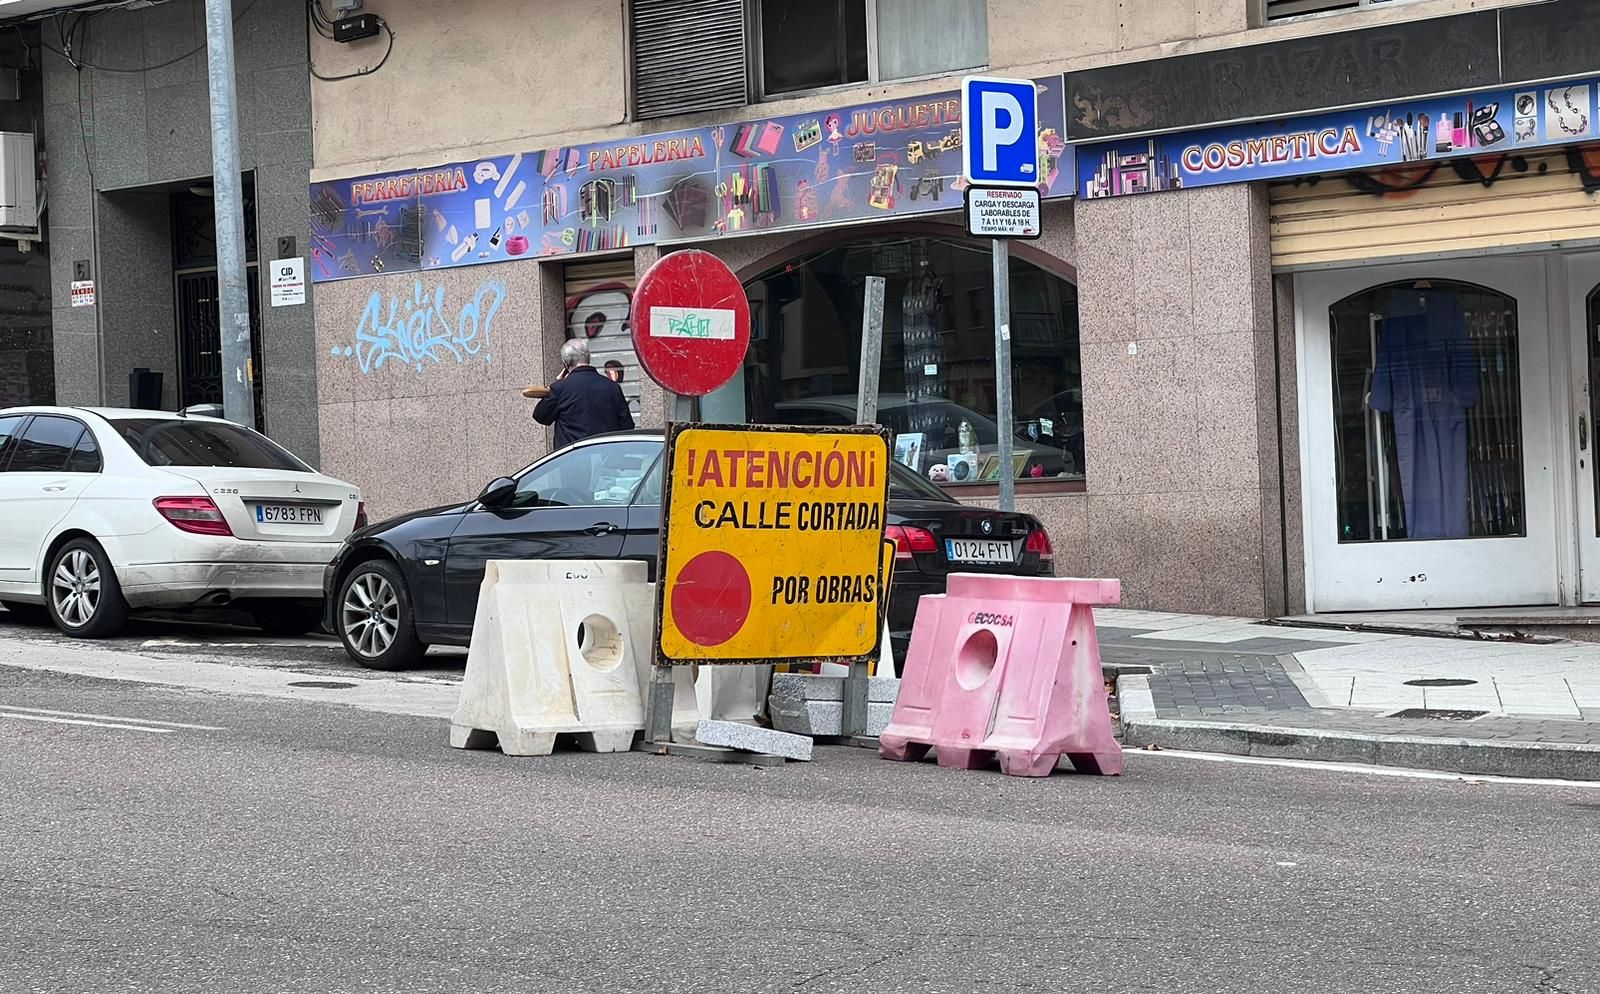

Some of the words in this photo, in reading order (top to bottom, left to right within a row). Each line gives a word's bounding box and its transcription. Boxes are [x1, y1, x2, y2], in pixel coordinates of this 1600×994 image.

[847, 99, 961, 136] JUGUETE
[981, 91, 1024, 172] P
[588, 136, 705, 172] PAPELERIA
[1183, 127, 1361, 172] COSMETICA
[351, 168, 467, 205] FERRETERIA
[986, 191, 1022, 199] RESERVADO
[974, 200, 997, 208] CARGA
[1002, 201, 1035, 209] DESCARGA
[980, 209, 1021, 217] LABORABLES
[986, 218, 991, 226] A
[992, 218, 998, 226] 11
[999, 218, 1004, 226] Y
[280, 267, 294, 276] CID
[265, 507, 296, 521] 6783
[300, 506, 322, 522] FPN
[694, 500, 792, 530] CALLE
[797, 501, 880, 531] CORTADA
[954, 541, 985, 558] 0124
[988, 543, 1009, 559] FYT
[771, 575, 810, 605] POR
[815, 574, 876, 604] OBRAS
